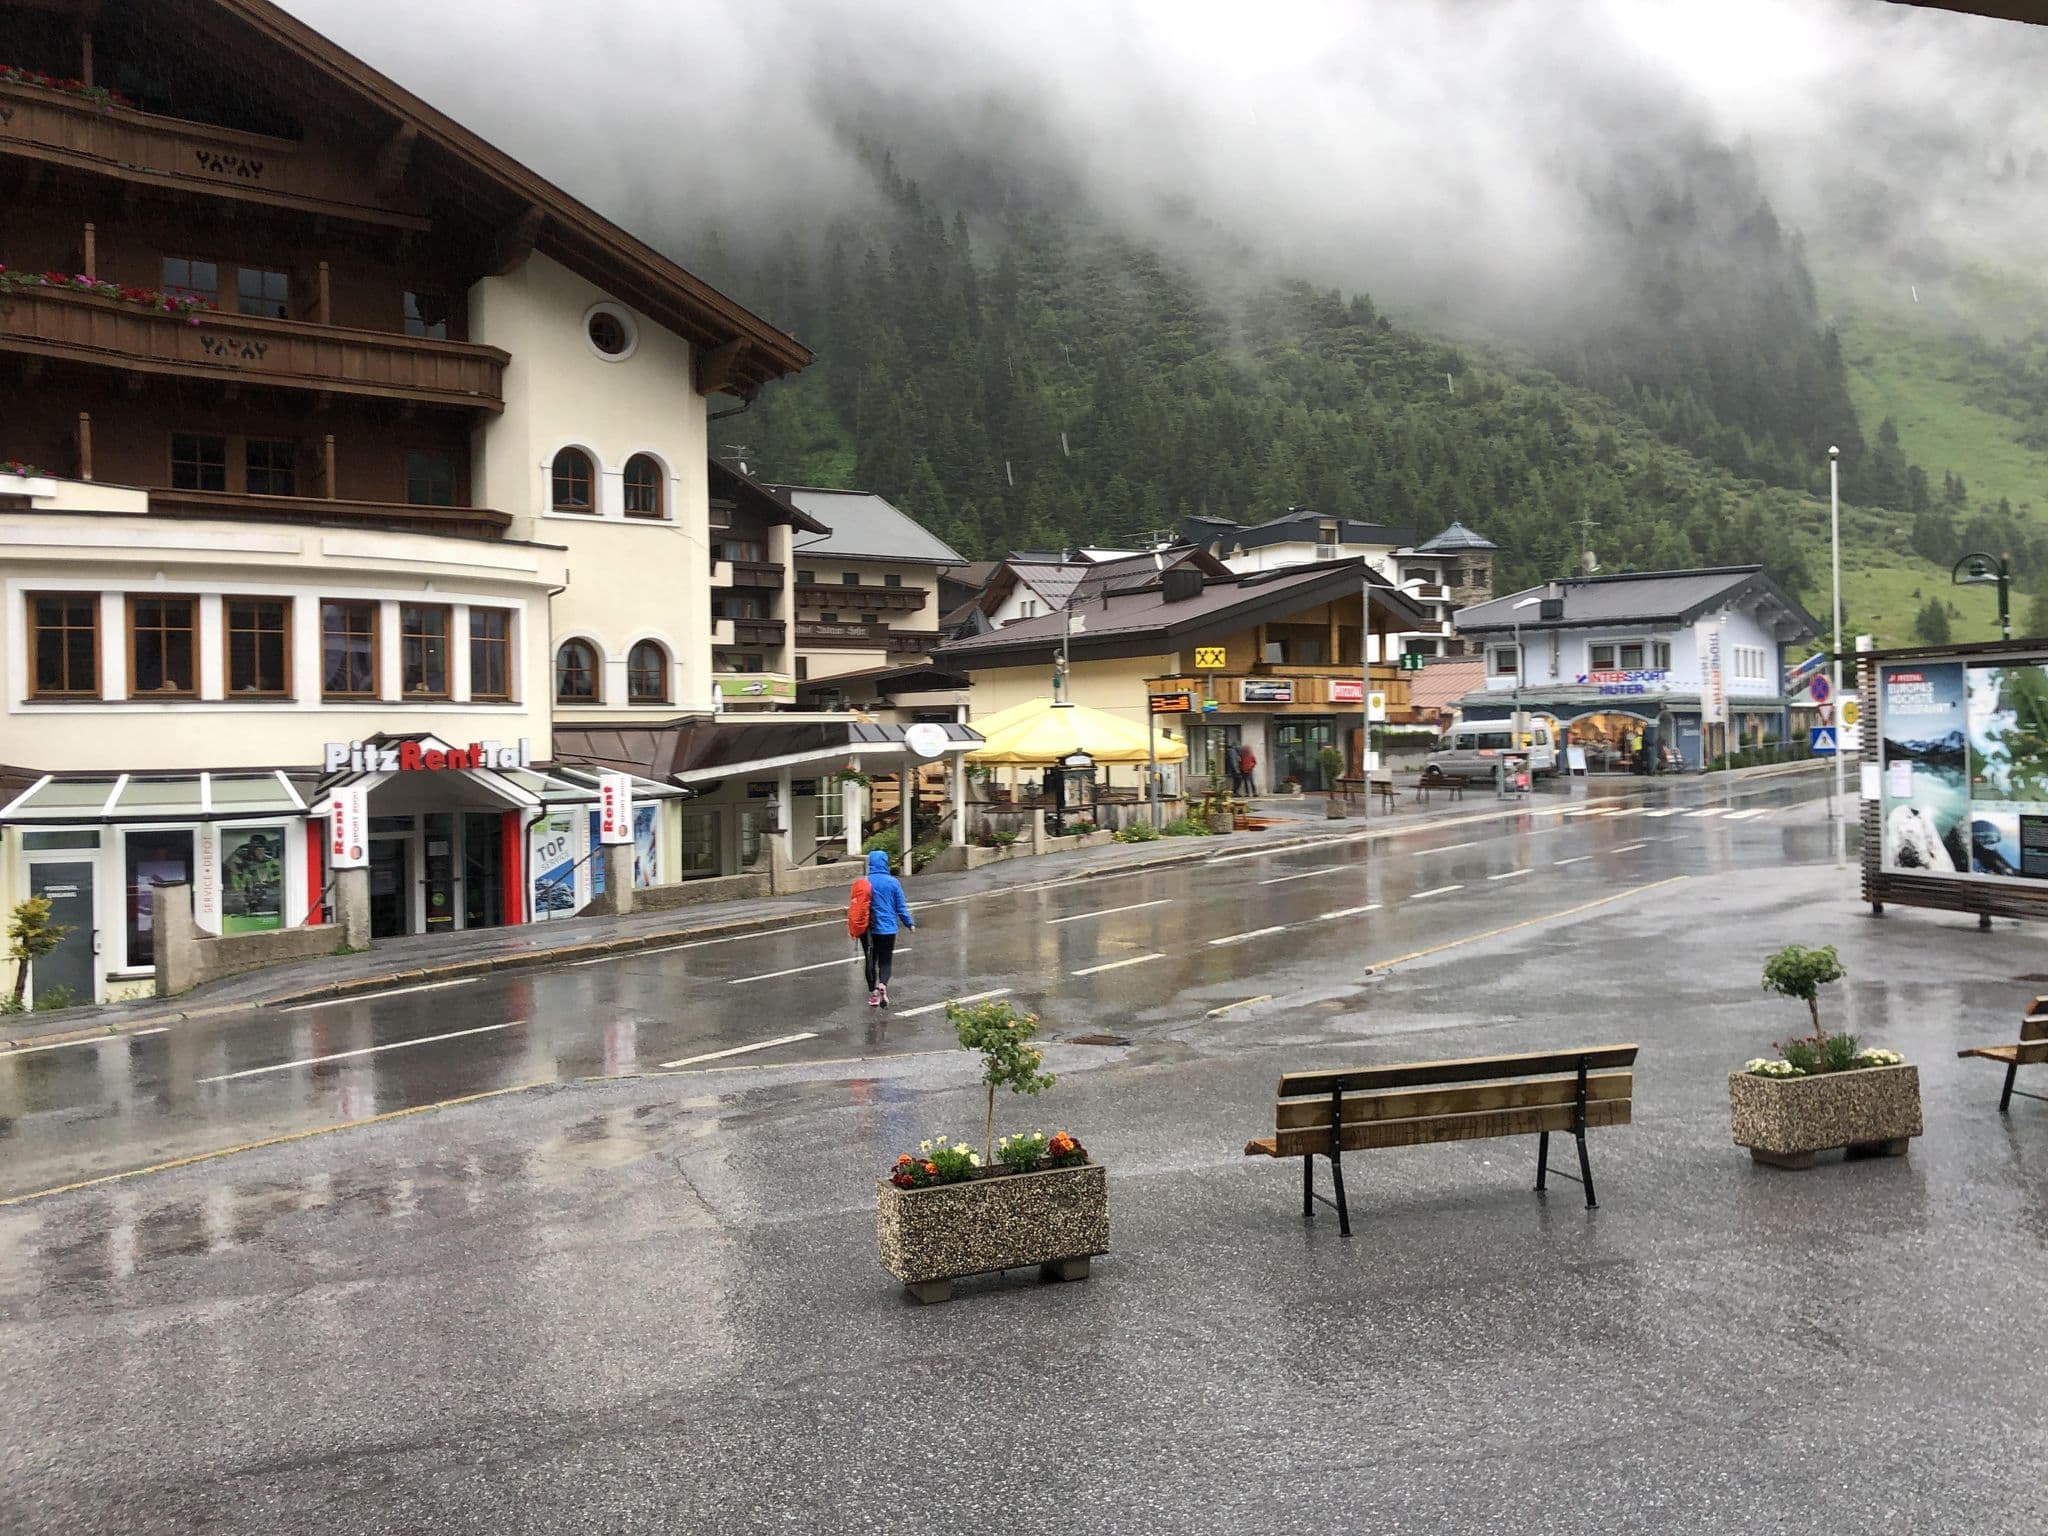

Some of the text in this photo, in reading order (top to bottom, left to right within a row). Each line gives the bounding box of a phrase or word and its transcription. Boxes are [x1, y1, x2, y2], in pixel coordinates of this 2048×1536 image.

[1588, 669, 1668, 683] INTERSPORT
[1599, 684, 1644, 696] HUTER
[603, 786, 614, 833] Rent
[332, 801, 345, 855] Rent
[352, 816, 360, 844] SPORT
[537, 836, 566, 862] TOP
[202, 837, 214, 912] SERVICE DEPOT
